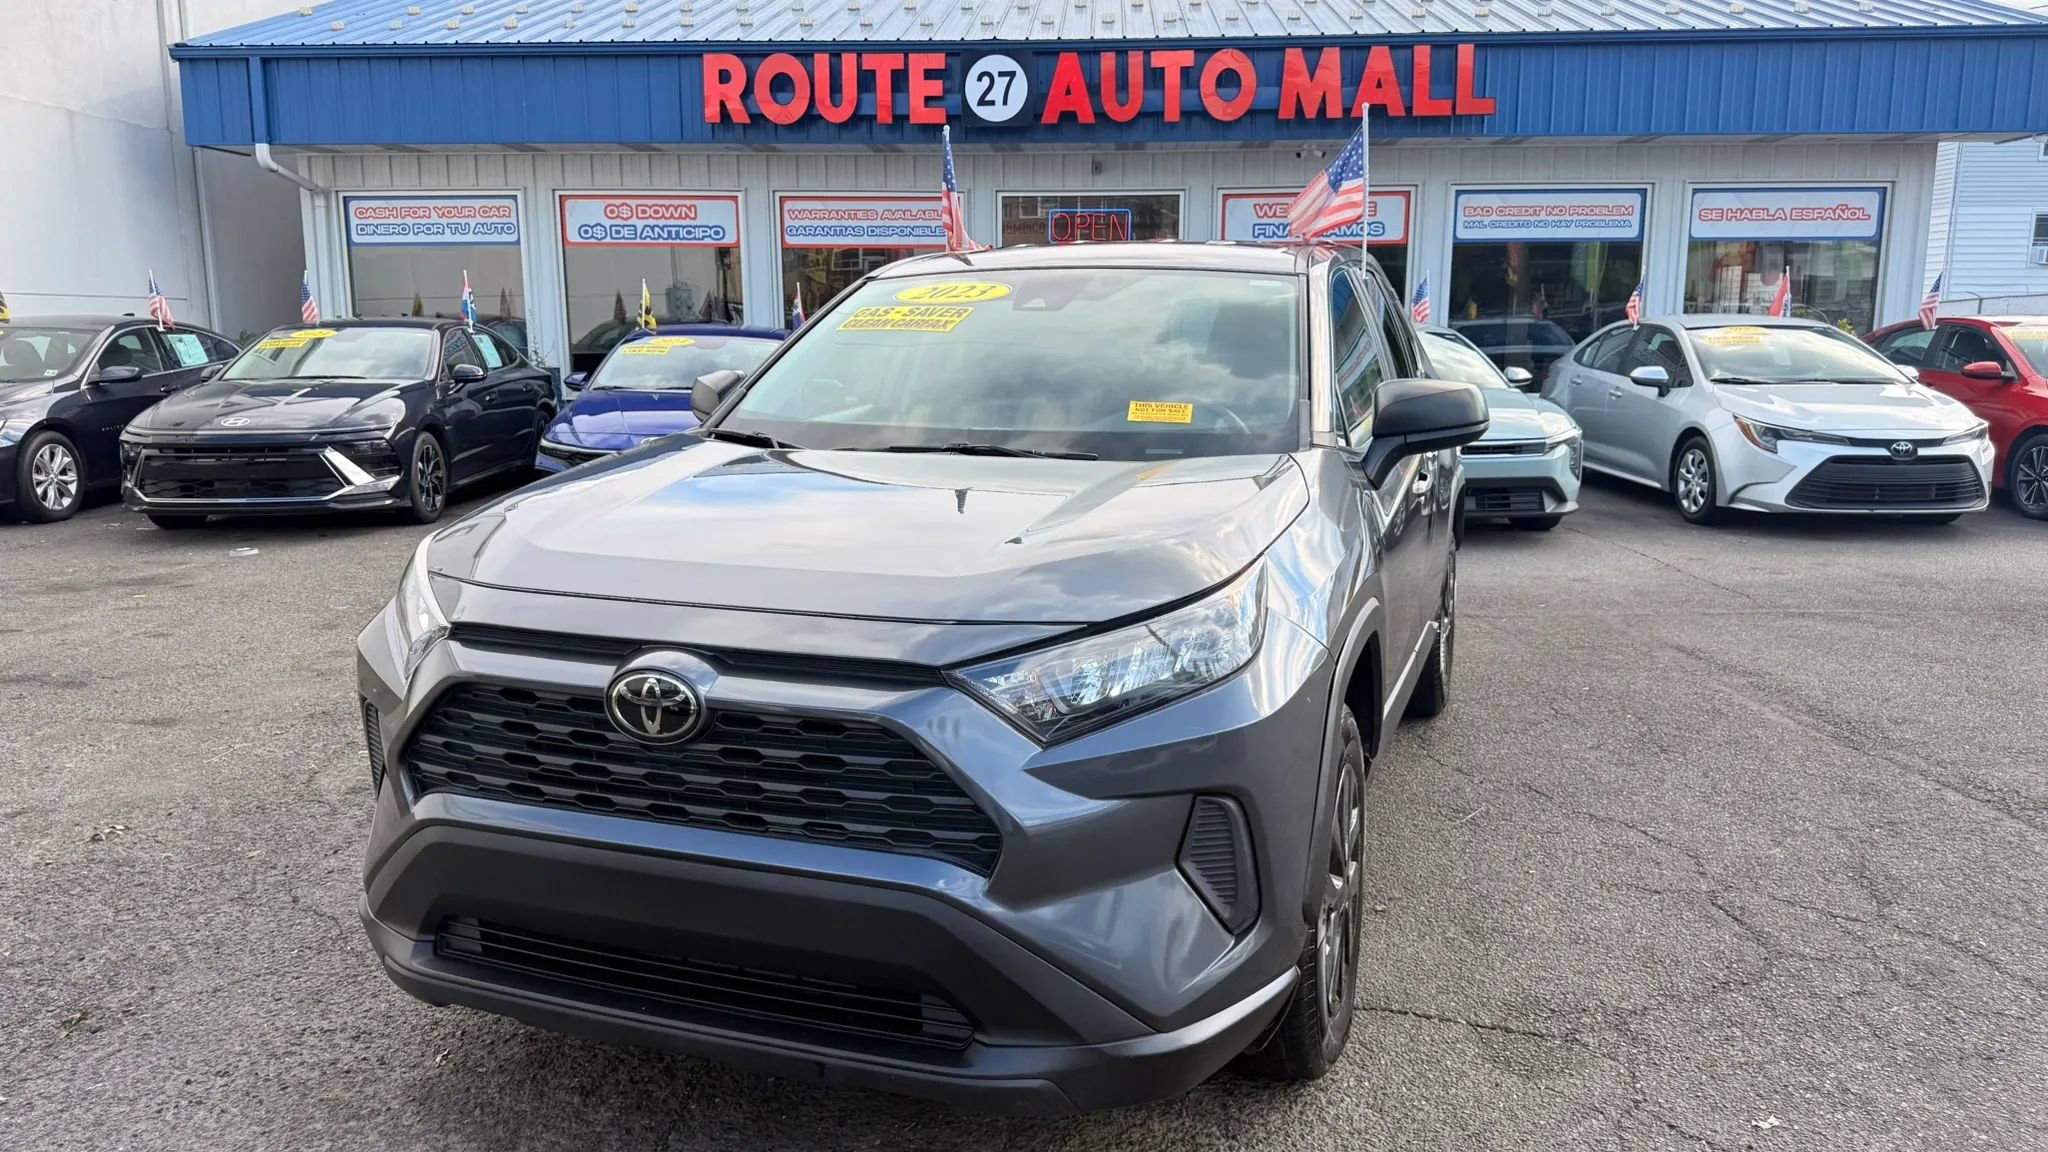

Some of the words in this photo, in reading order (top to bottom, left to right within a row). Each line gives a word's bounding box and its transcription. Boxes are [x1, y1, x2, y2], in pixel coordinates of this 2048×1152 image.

[703, 52, 947, 125] ROUTE
[976, 71, 1017, 107] 27
[1040, 48, 1257, 125] AUTO
[1277, 43, 1497, 120] MALL
[355, 206, 397, 219] CASH
[400, 206, 431, 219] FOR
[434, 206, 476, 218] YOUR
[478, 205, 511, 218] CAR
[635, 204, 697, 220] DOWN
[788, 209, 877, 221] WARRANTIES
[880, 209, 943, 221] AVAILABL
[1254, 202, 1289, 219] WE
[1463, 206, 1492, 217] BAD
[1495, 205, 1543, 217] CREDIT
[1545, 205, 1566, 217] NO
[1568, 205, 1634, 217] PROBLEM
[1698, 208, 1723, 221] SE
[1725, 208, 1787, 221] HABLA
[1790, 203, 1871, 221] ESPAÑOL
[356, 223, 410, 236] DINERO
[413, 223, 445, 235] POR
[447, 223, 470, 235] TU
[472, 222, 516, 235] AUTO
[786, 225, 865, 237] GARANTIAS
[867, 225, 946, 237] DISPONIBLE
[1052, 212, 1129, 242] OPEN
[1252, 221, 1385, 239] FINAMOS
[1463, 220, 1487, 229] MAL
[1489, 220, 1531, 229] CREDITO
[1533, 219, 1549, 228] NO
[1551, 219, 1573, 228] HAY
[1574, 219, 1632, 228] PROBLEMA
[609, 225, 637, 241] DE
[639, 224, 726, 241] ANTICIPO
[910, 284, 997, 300] 2023
[854, 307, 892, 318] GAS
[901, 307, 970, 318] SAVER
